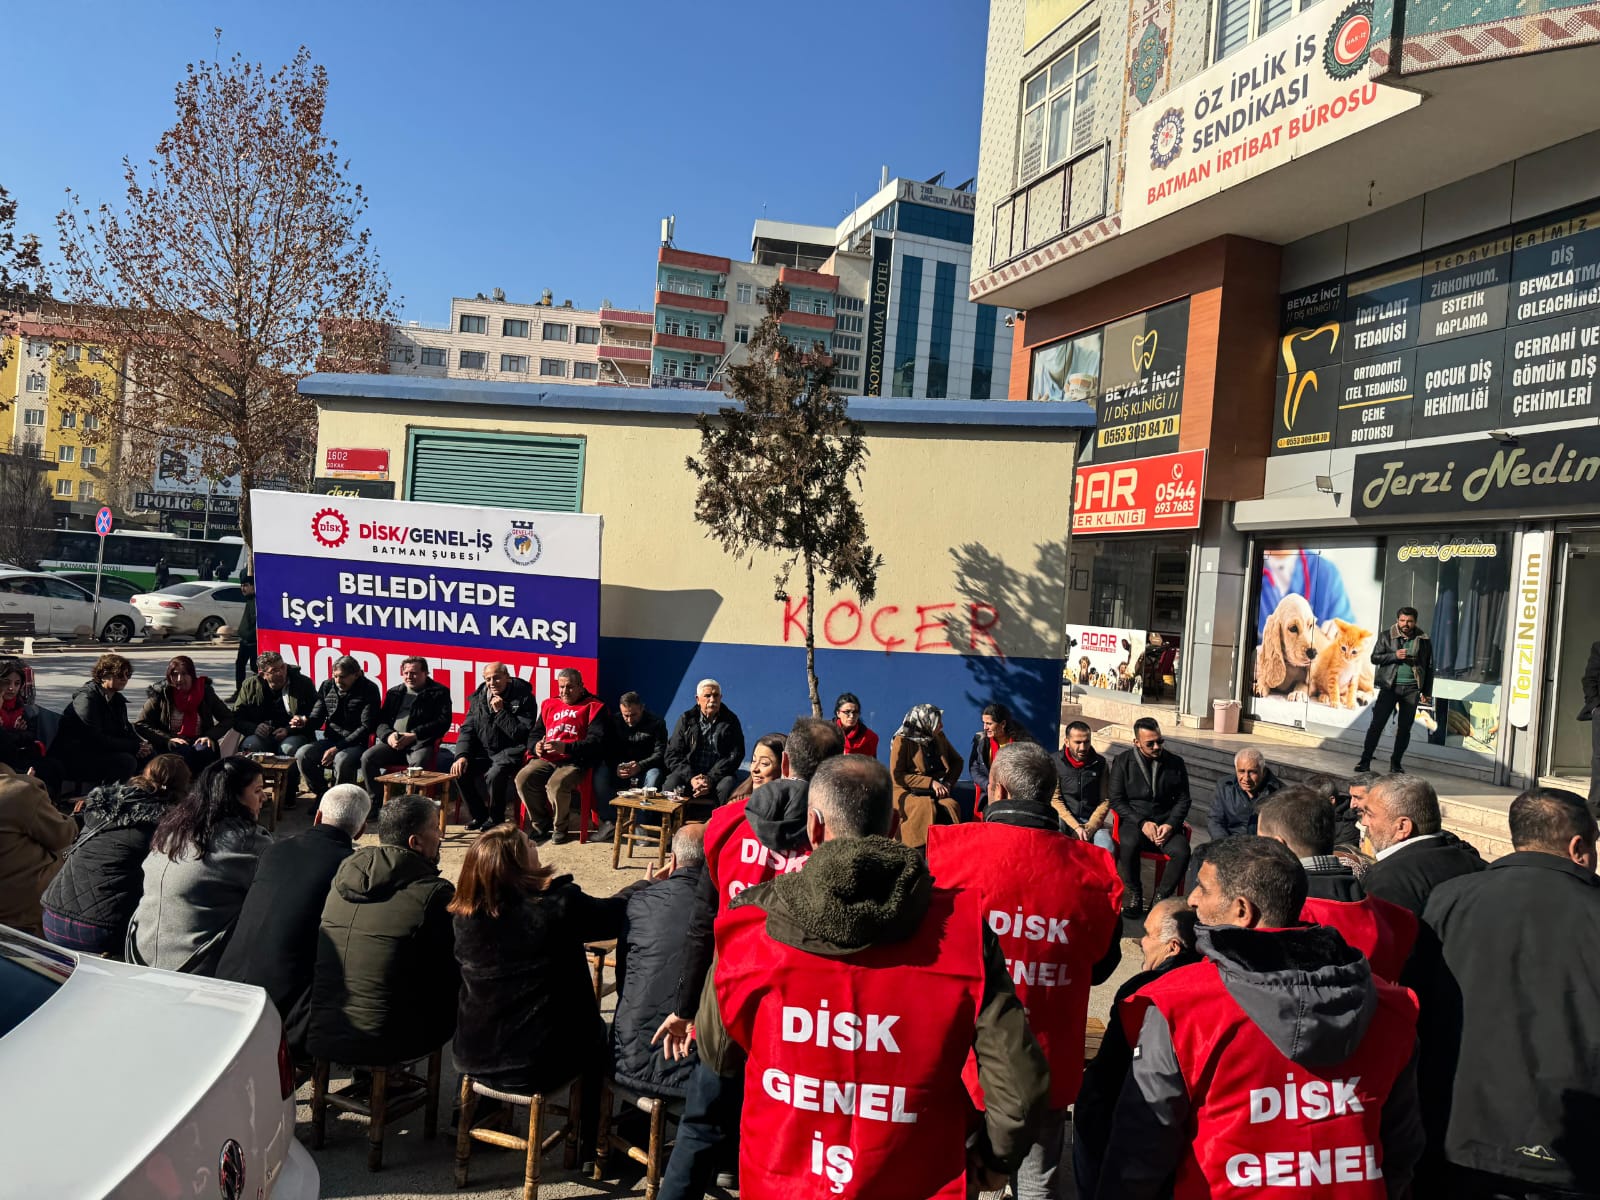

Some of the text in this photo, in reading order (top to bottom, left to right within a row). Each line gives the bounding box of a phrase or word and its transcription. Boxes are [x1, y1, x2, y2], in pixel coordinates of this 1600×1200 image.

[1194, 34, 1316, 120] ÖZ İPLİK İŞ
[1191, 74, 1309, 153] SENDİKASI
[1147, 160, 1211, 205] BATMAN
[1216, 125, 1283, 173] İRTİBAT
[1288, 82, 1377, 140] BÜROSU
[1550, 244, 1574, 266] DİŞ
[873, 259, 889, 305] HOTEL
[1287, 284, 1341, 310] BEYAZ İNCİ
[1355, 298, 1408, 326] İMPLANT
[1442, 291, 1485, 315] ESTETİK
[1354, 320, 1407, 350] TEDAVİSİ
[1436, 312, 1488, 336] KAPLAMA
[1514, 326, 1600, 359] CERRAHİ VE
[1105, 365, 1181, 402] BEYAZ İNCİ
[1353, 357, 1401, 381] ORTODONTİ
[1425, 359, 1492, 393] ÇOCUK DİŞ
[1513, 353, 1597, 387] GÖMÜK DİŞ
[1345, 376, 1407, 401] (TEL TEDAVİSİ)
[1424, 386, 1490, 418] HEKİMLİĞİ
[1513, 381, 1592, 417] ÇEKİMLERİ
[1114, 402, 1129, 421] DİŞ
[1131, 392, 1166, 416] KLİNİĞİ
[1361, 407, 1387, 424] ÇENE
[1104, 418, 1174, 445] 0553 309 84 70
[1351, 425, 1394, 442] BOTOKSU
[1155, 480, 1196, 502] 0544
[1362, 461, 1455, 509] Terzi
[1096, 510, 1145, 526] KLİNİĞİ
[1154, 500, 1194, 513] 693 7683
[320, 521, 341, 532] DİSK
[360, 521, 493, 552] DİSK/GENEL-İŞ
[373, 546, 480, 561] BATMAN ŞUBESİ
[339, 572, 515, 608] BELEDİYEDE
[282, 592, 577, 649] İŞÇİ KIYIMINA KARŞI
[1082, 632, 1117, 648] ADAR
[989, 906, 1070, 944] DİSK
[782, 999, 900, 1053] DİSK
[762, 1067, 917, 1123] GENEL
[1250, 1073, 1365, 1124] DİSK
[811, 1131, 854, 1193] İŞ
[1225, 1145, 1383, 1187] GENEL
